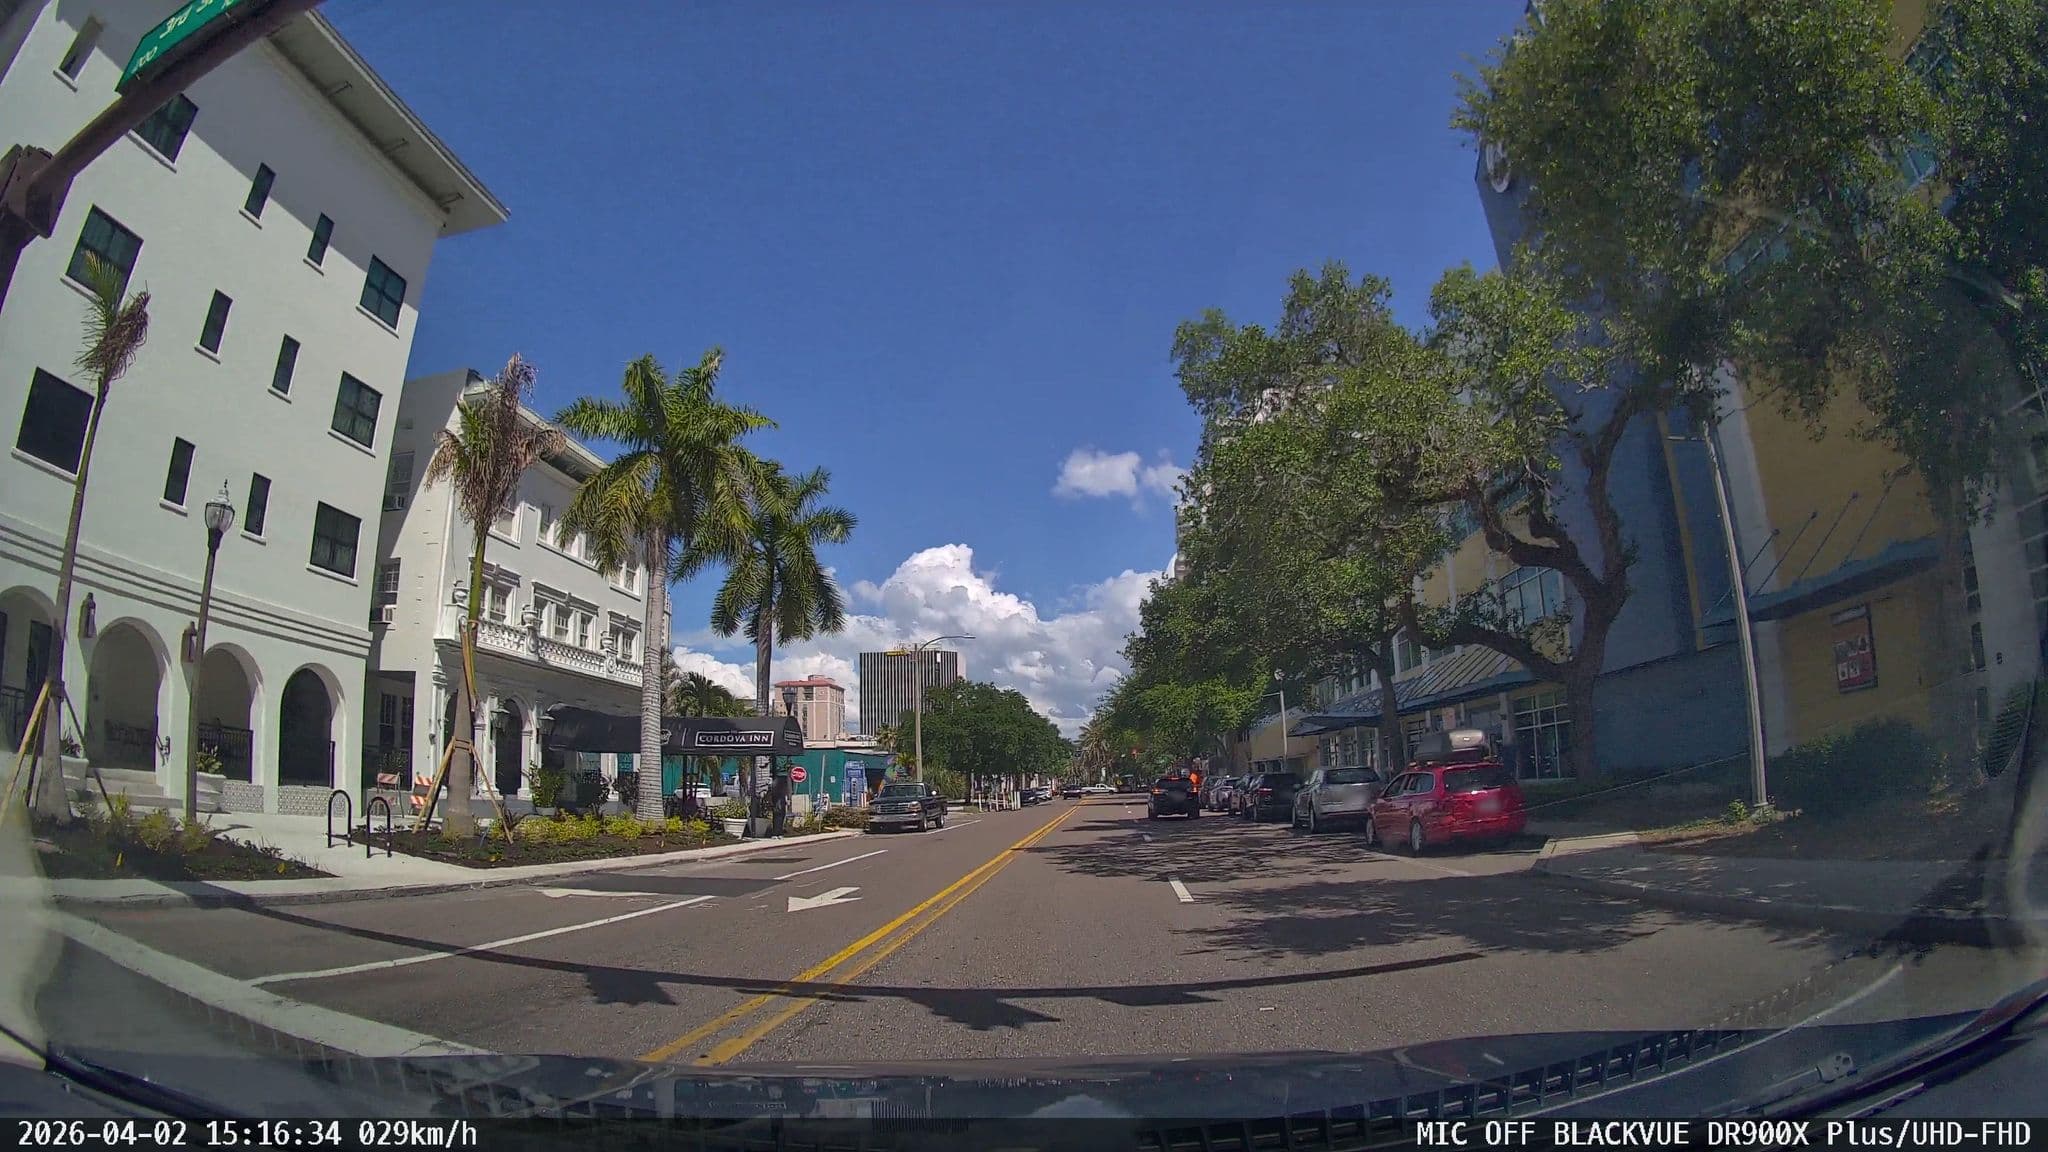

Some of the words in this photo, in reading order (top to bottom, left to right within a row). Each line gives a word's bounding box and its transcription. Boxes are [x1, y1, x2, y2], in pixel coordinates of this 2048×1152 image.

[159, 5, 193, 39] 3rd
[699, 734, 746, 743] CORDOVA
[749, 734, 769, 743] INN
